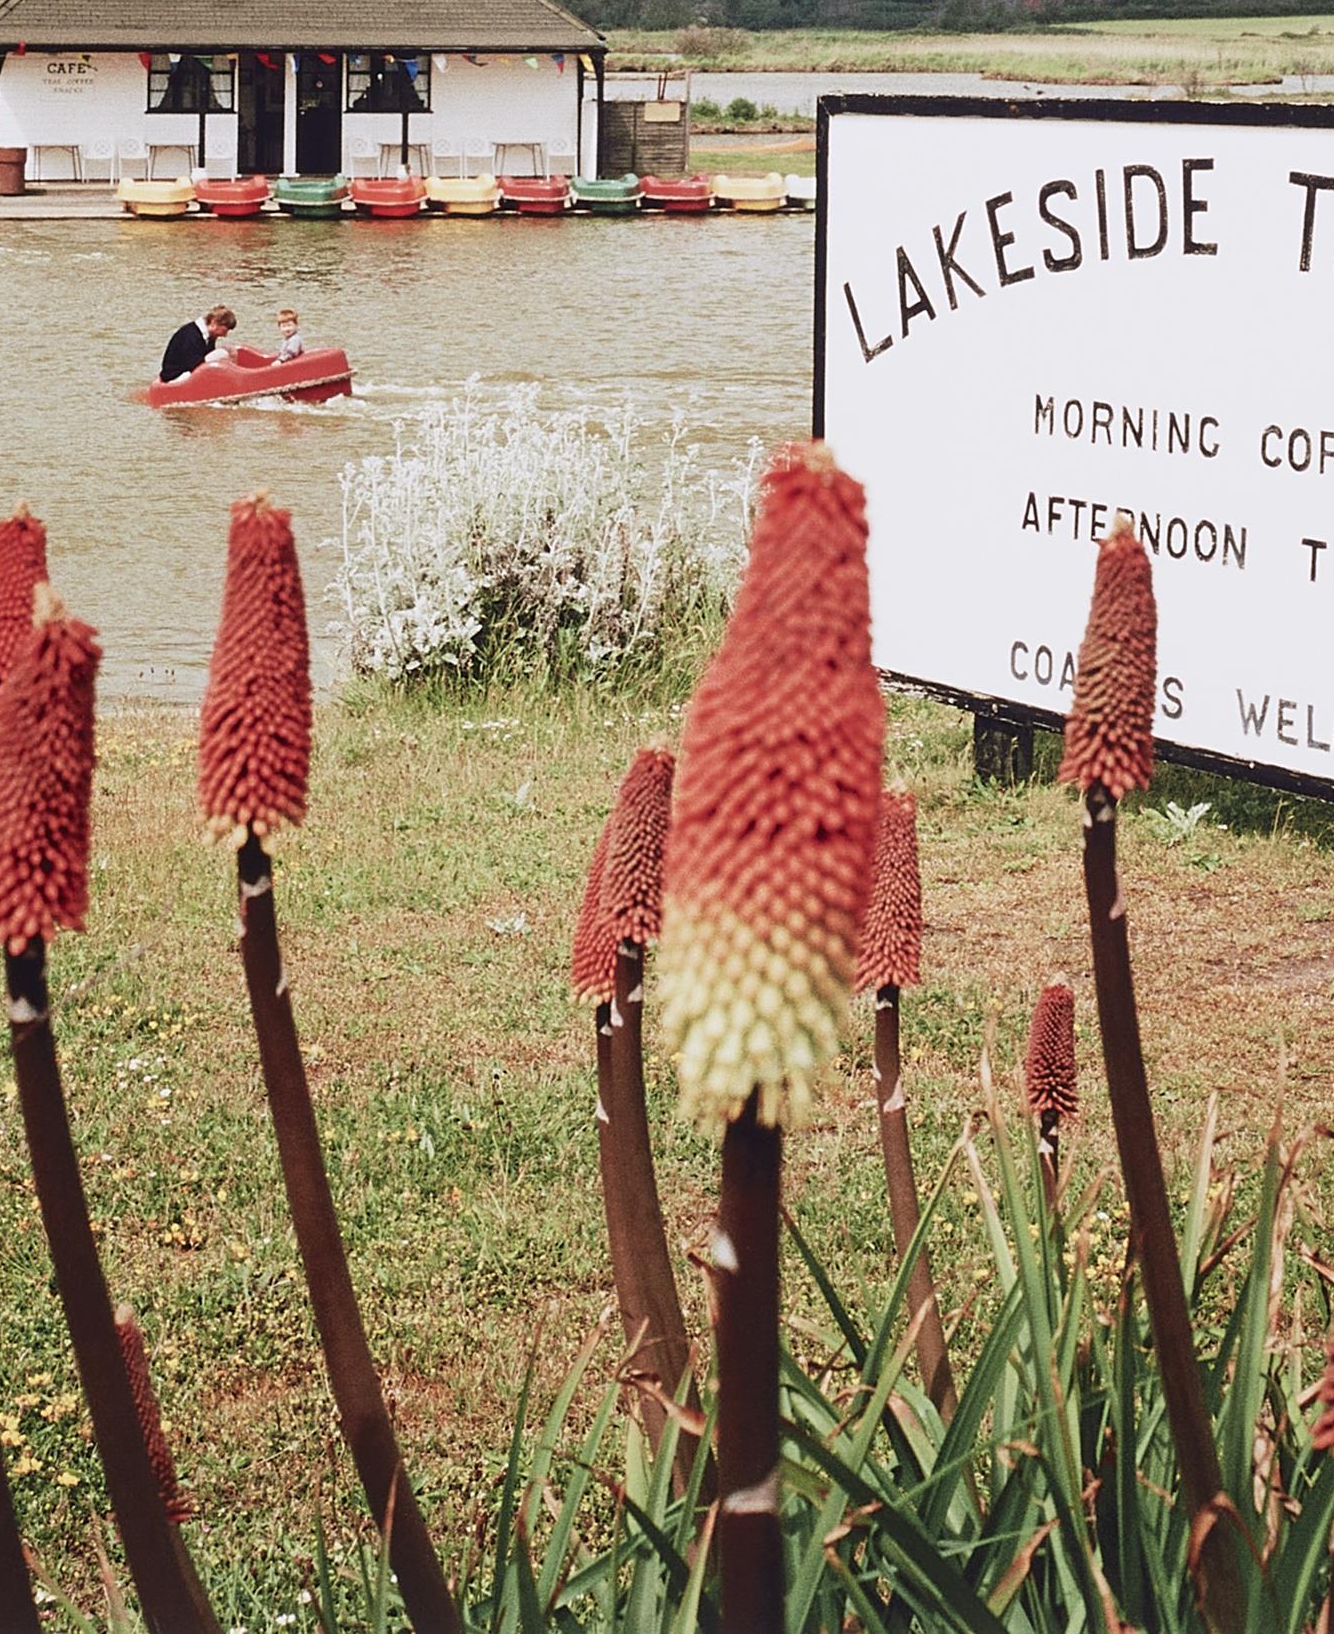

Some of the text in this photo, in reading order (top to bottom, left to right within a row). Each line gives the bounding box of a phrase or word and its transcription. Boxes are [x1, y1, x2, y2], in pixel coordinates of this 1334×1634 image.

[843, 158, 1219, 364] LAKESIDE
[1034, 394, 1221, 458] MORNING
[1010, 640, 1185, 720] COAS
